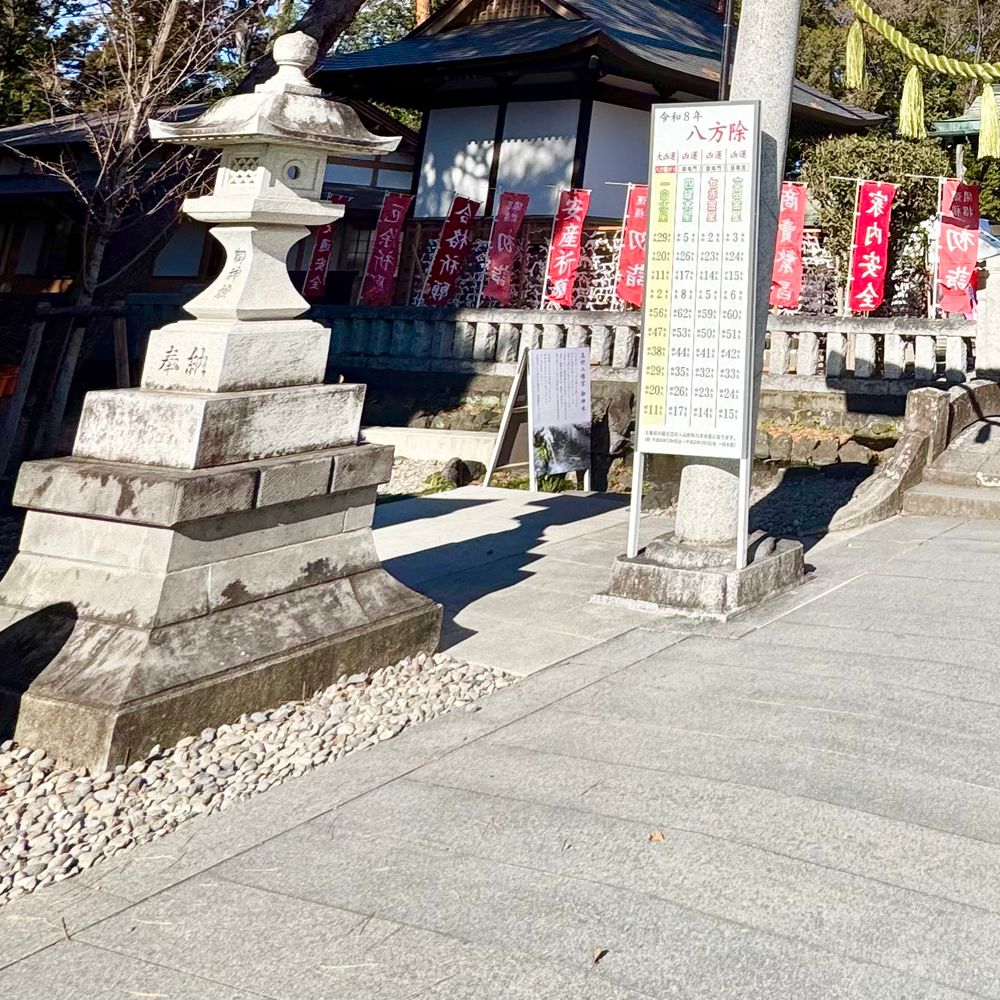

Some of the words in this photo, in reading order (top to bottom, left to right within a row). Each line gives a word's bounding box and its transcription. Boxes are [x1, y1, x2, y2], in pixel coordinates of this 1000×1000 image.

[659, 110, 702, 122] 令和8年
[686, 120, 749, 143] 八方除
[158, 344, 209, 376] 奉納
